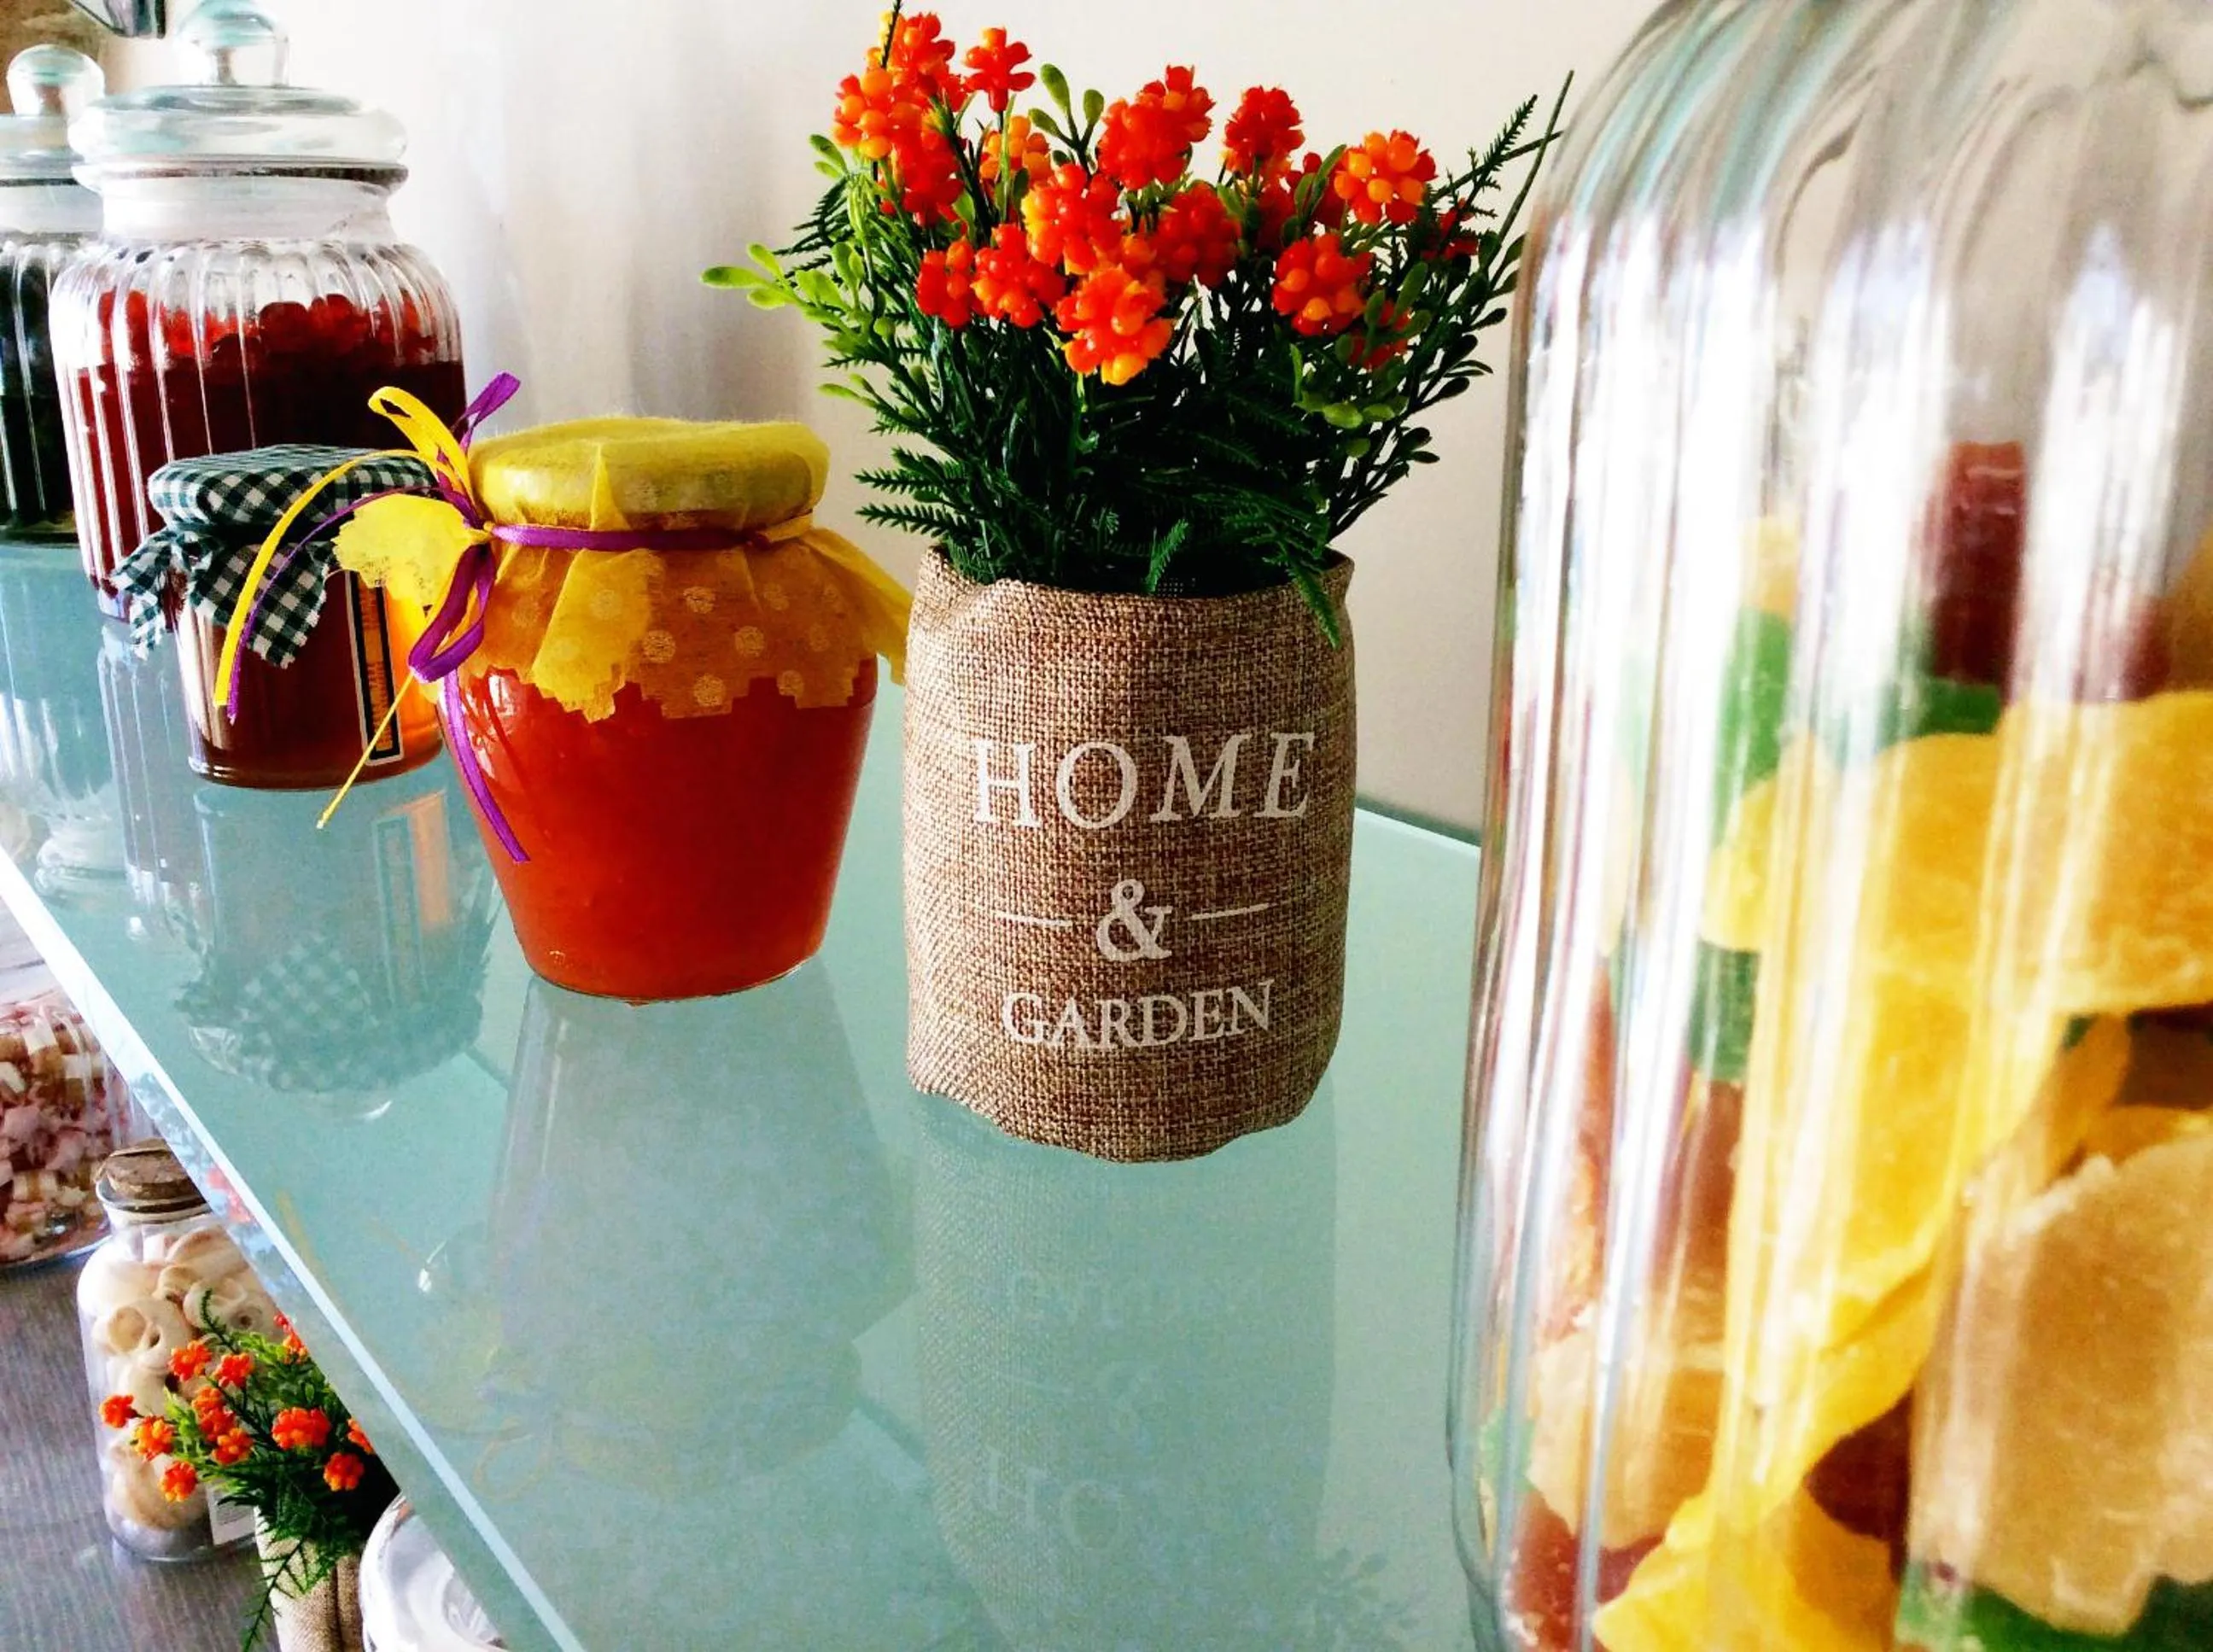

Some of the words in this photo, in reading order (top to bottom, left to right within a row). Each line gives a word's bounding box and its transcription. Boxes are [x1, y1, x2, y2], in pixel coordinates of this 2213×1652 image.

[973, 732, 1315, 830] HOME
[1096, 879, 1172, 962] &
[1001, 982, 1275, 1049] GARDEN
